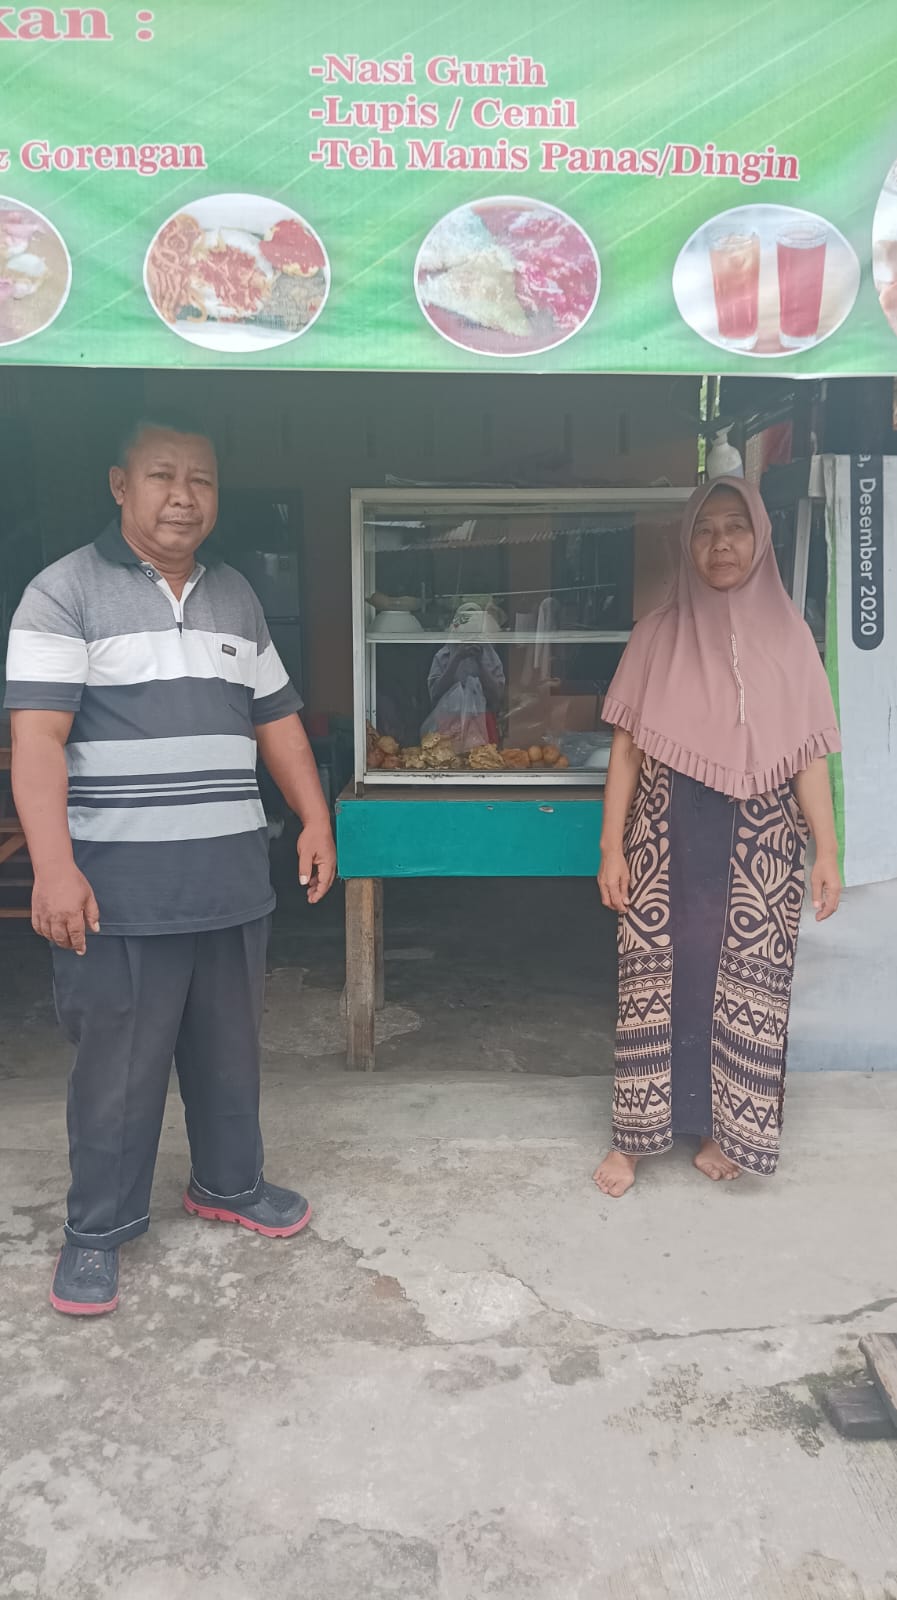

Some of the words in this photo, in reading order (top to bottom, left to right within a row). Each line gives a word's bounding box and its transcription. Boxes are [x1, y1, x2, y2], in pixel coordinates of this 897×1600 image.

[310, 54, 414, 84] -Nasi
[426, 56, 547, 86] Gurih
[310, 96, 438, 131] -Lupis
[447, 98, 462, 130] /
[472, 98, 577, 129] Cenil
[20, 141, 205, 174] Gorengan
[310, 138, 396, 169] -Teh
[407, 139, 529, 171] Manis
[541, 142, 799, 184] Panas/Dingin
[859, 477, 877, 581] Desember
[860, 585, 878, 636] 2020
